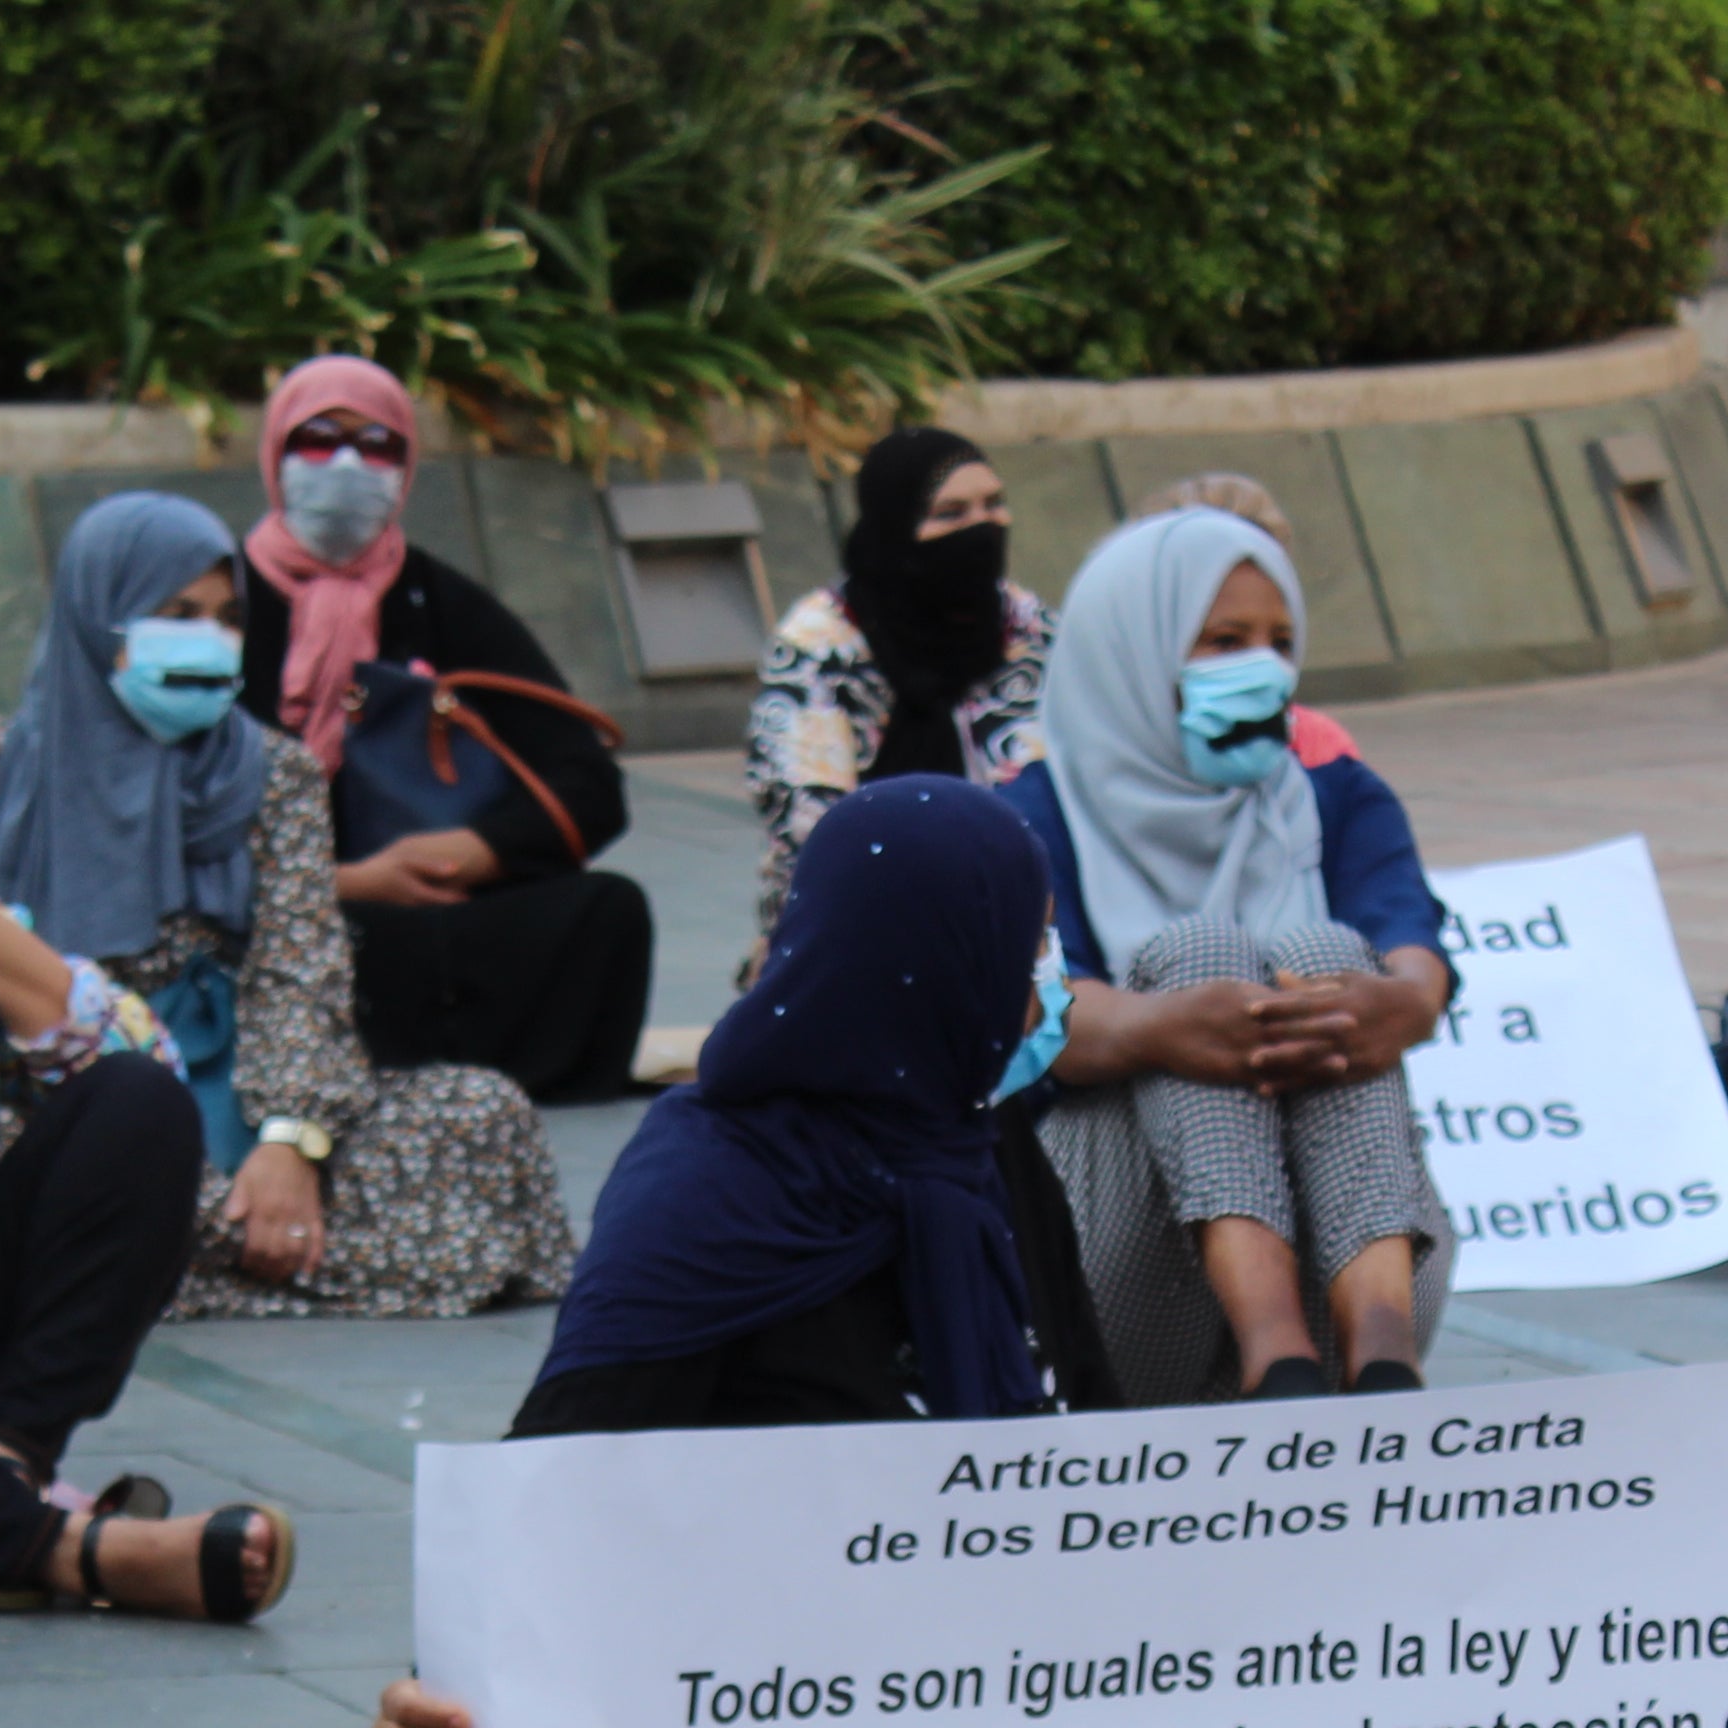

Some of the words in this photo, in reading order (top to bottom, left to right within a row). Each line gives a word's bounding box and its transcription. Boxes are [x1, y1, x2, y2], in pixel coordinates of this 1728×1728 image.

[1438, 903, 1571, 954] dad
[1500, 1005, 1539, 1043] a
[1443, 1179, 1722, 1242] ueridos
[938, 1443, 1190, 1495] Artículo
[1215, 1436, 1247, 1478] 7
[1265, 1431, 1337, 1473] de
[1358, 1426, 1408, 1465] la
[1429, 1412, 1585, 1458] Carta
[845, 1522, 920, 1566] de
[942, 1518, 1034, 1560] los
[1059, 1499, 1349, 1553] Derechos
[1372, 1475, 1655, 1528] Humanos
[677, 1665, 856, 1728] Todos
[877, 1665, 985, 1714] son
[1007, 1640, 1214, 1720] iguales
[1235, 1630, 1359, 1689] ante
[1380, 1621, 1426, 1679] la
[1448, 1617, 1530, 1686] ley
[1547, 1624, 1581, 1685] y
